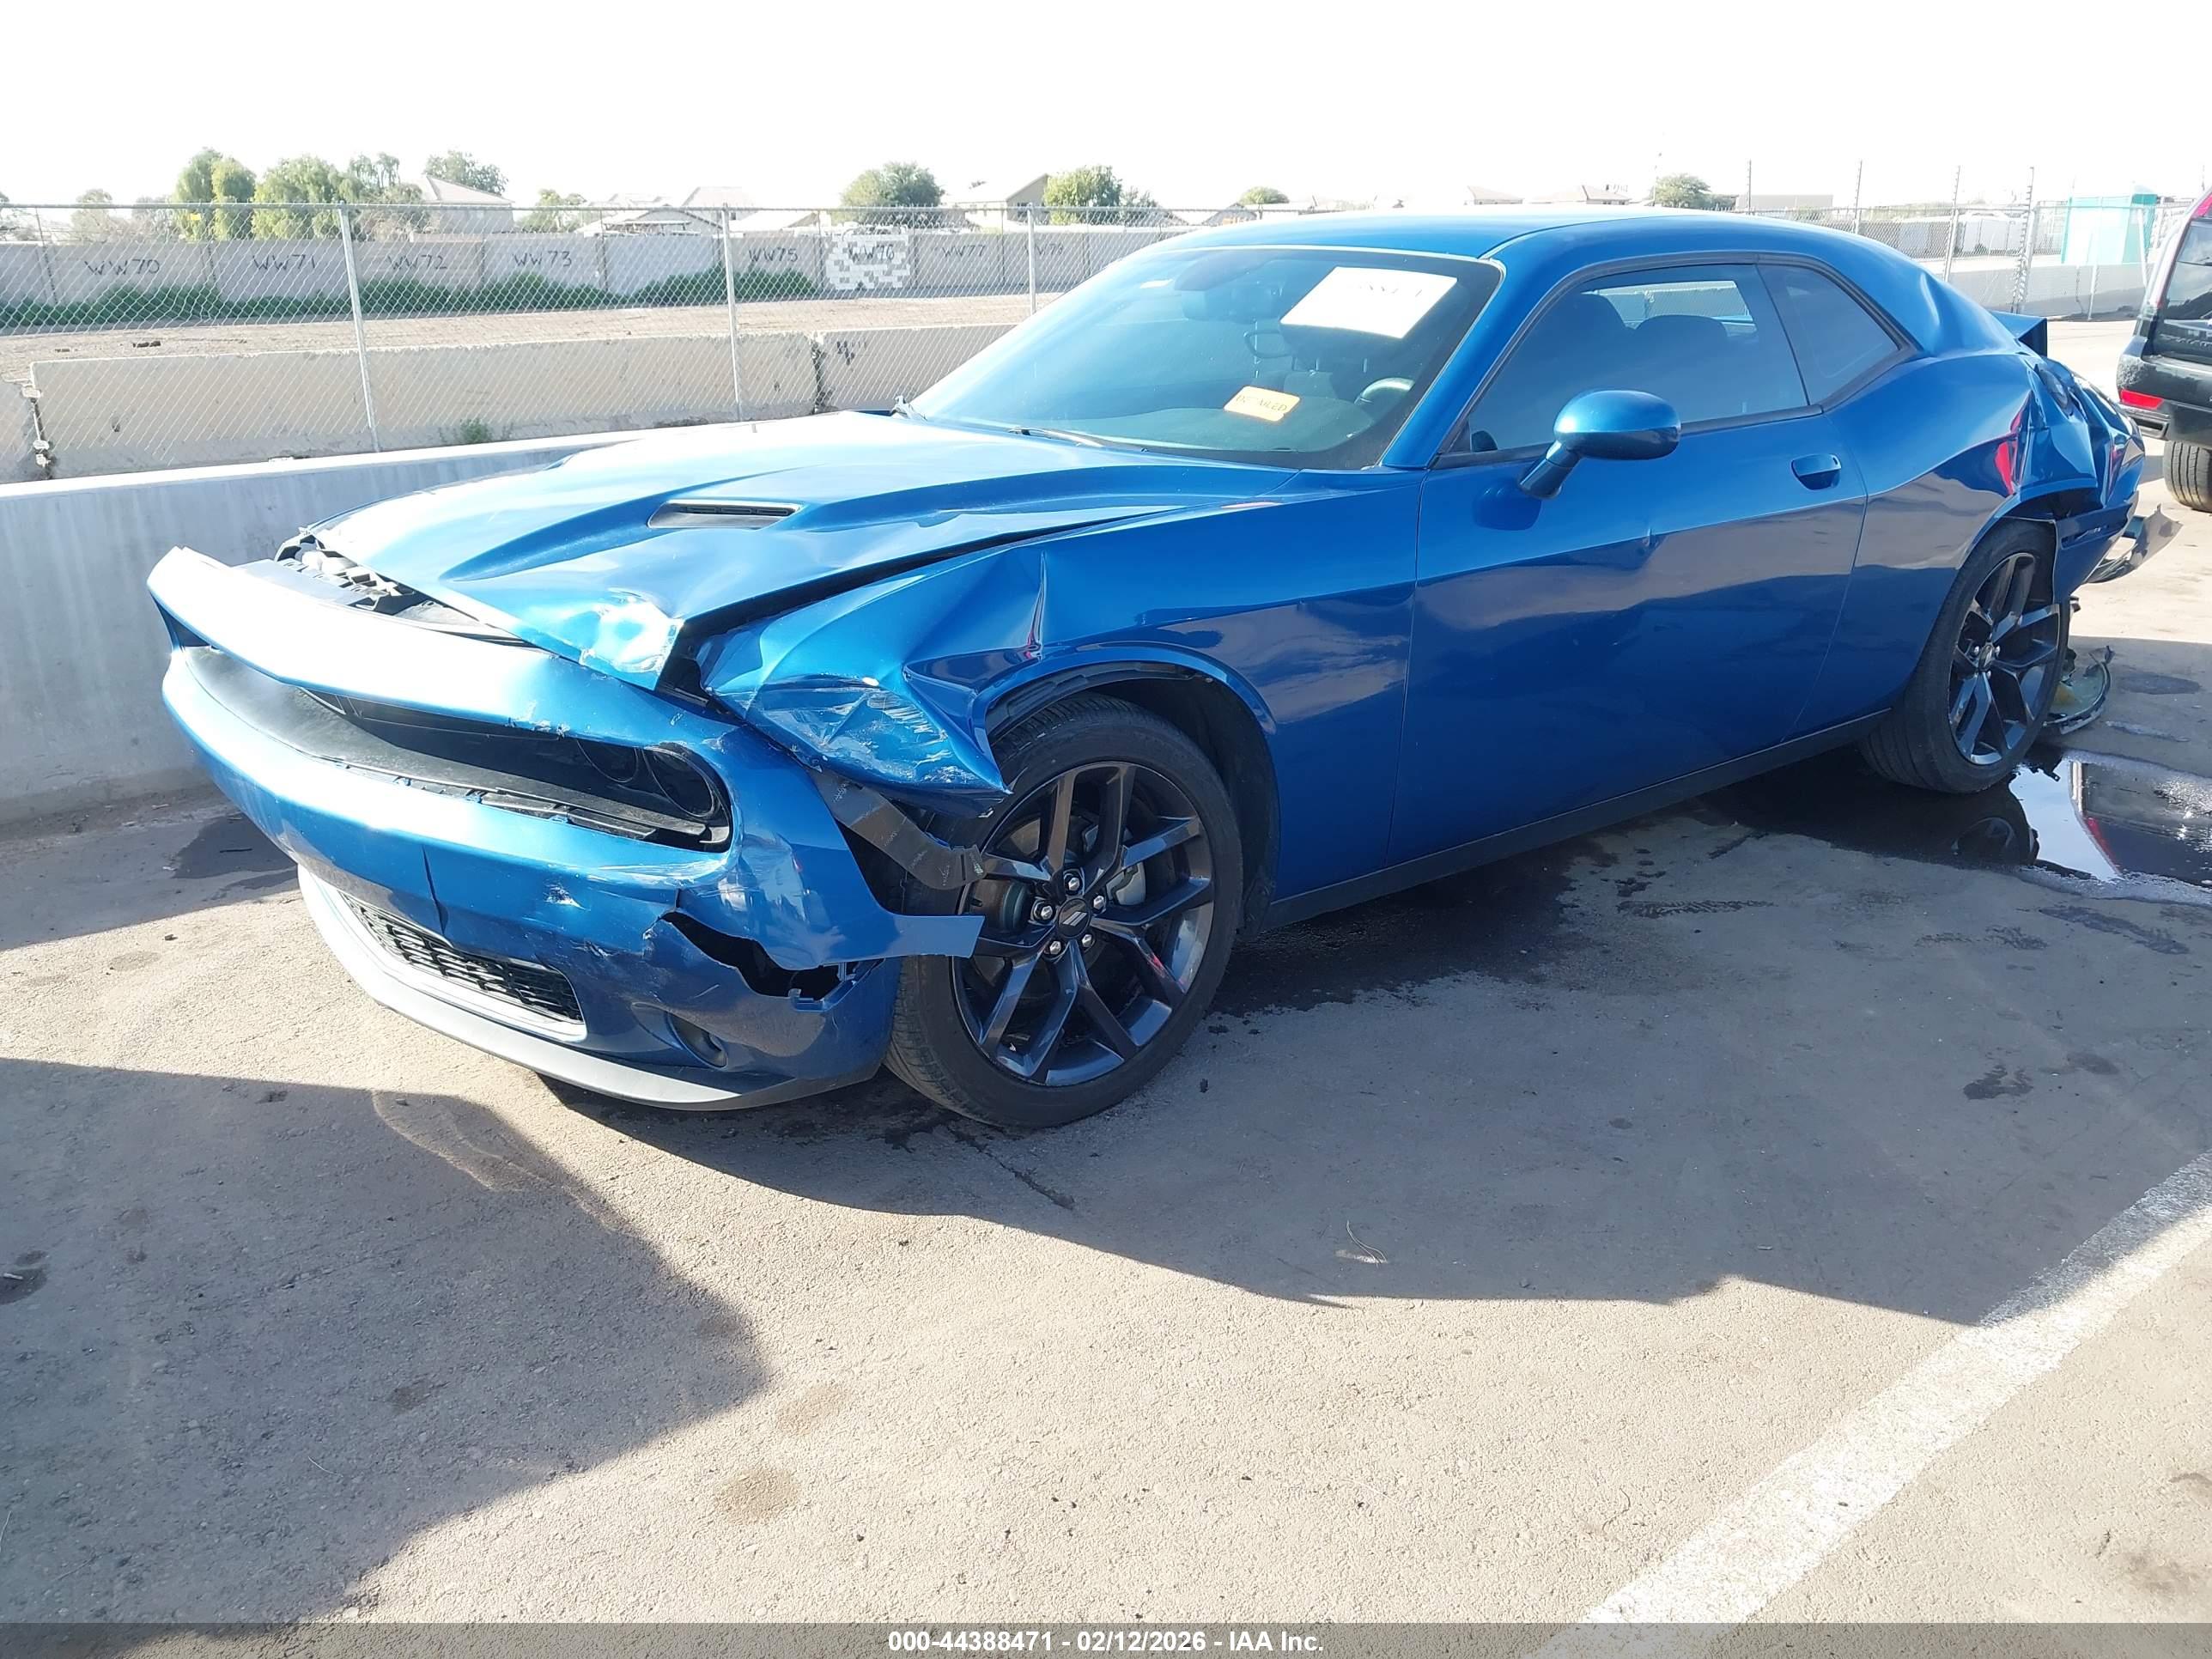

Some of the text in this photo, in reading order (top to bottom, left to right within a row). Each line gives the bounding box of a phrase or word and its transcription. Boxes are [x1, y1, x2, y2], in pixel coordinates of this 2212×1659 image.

[512, 250, 573, 269] WW73
[748, 246, 799, 266] WW75
[848, 243, 895, 262] WW76
[941, 245, 986, 258] WW77
[84, 258, 161, 276] WW70
[252, 253, 317, 271] WW71
[387, 253, 448, 270] WW72
